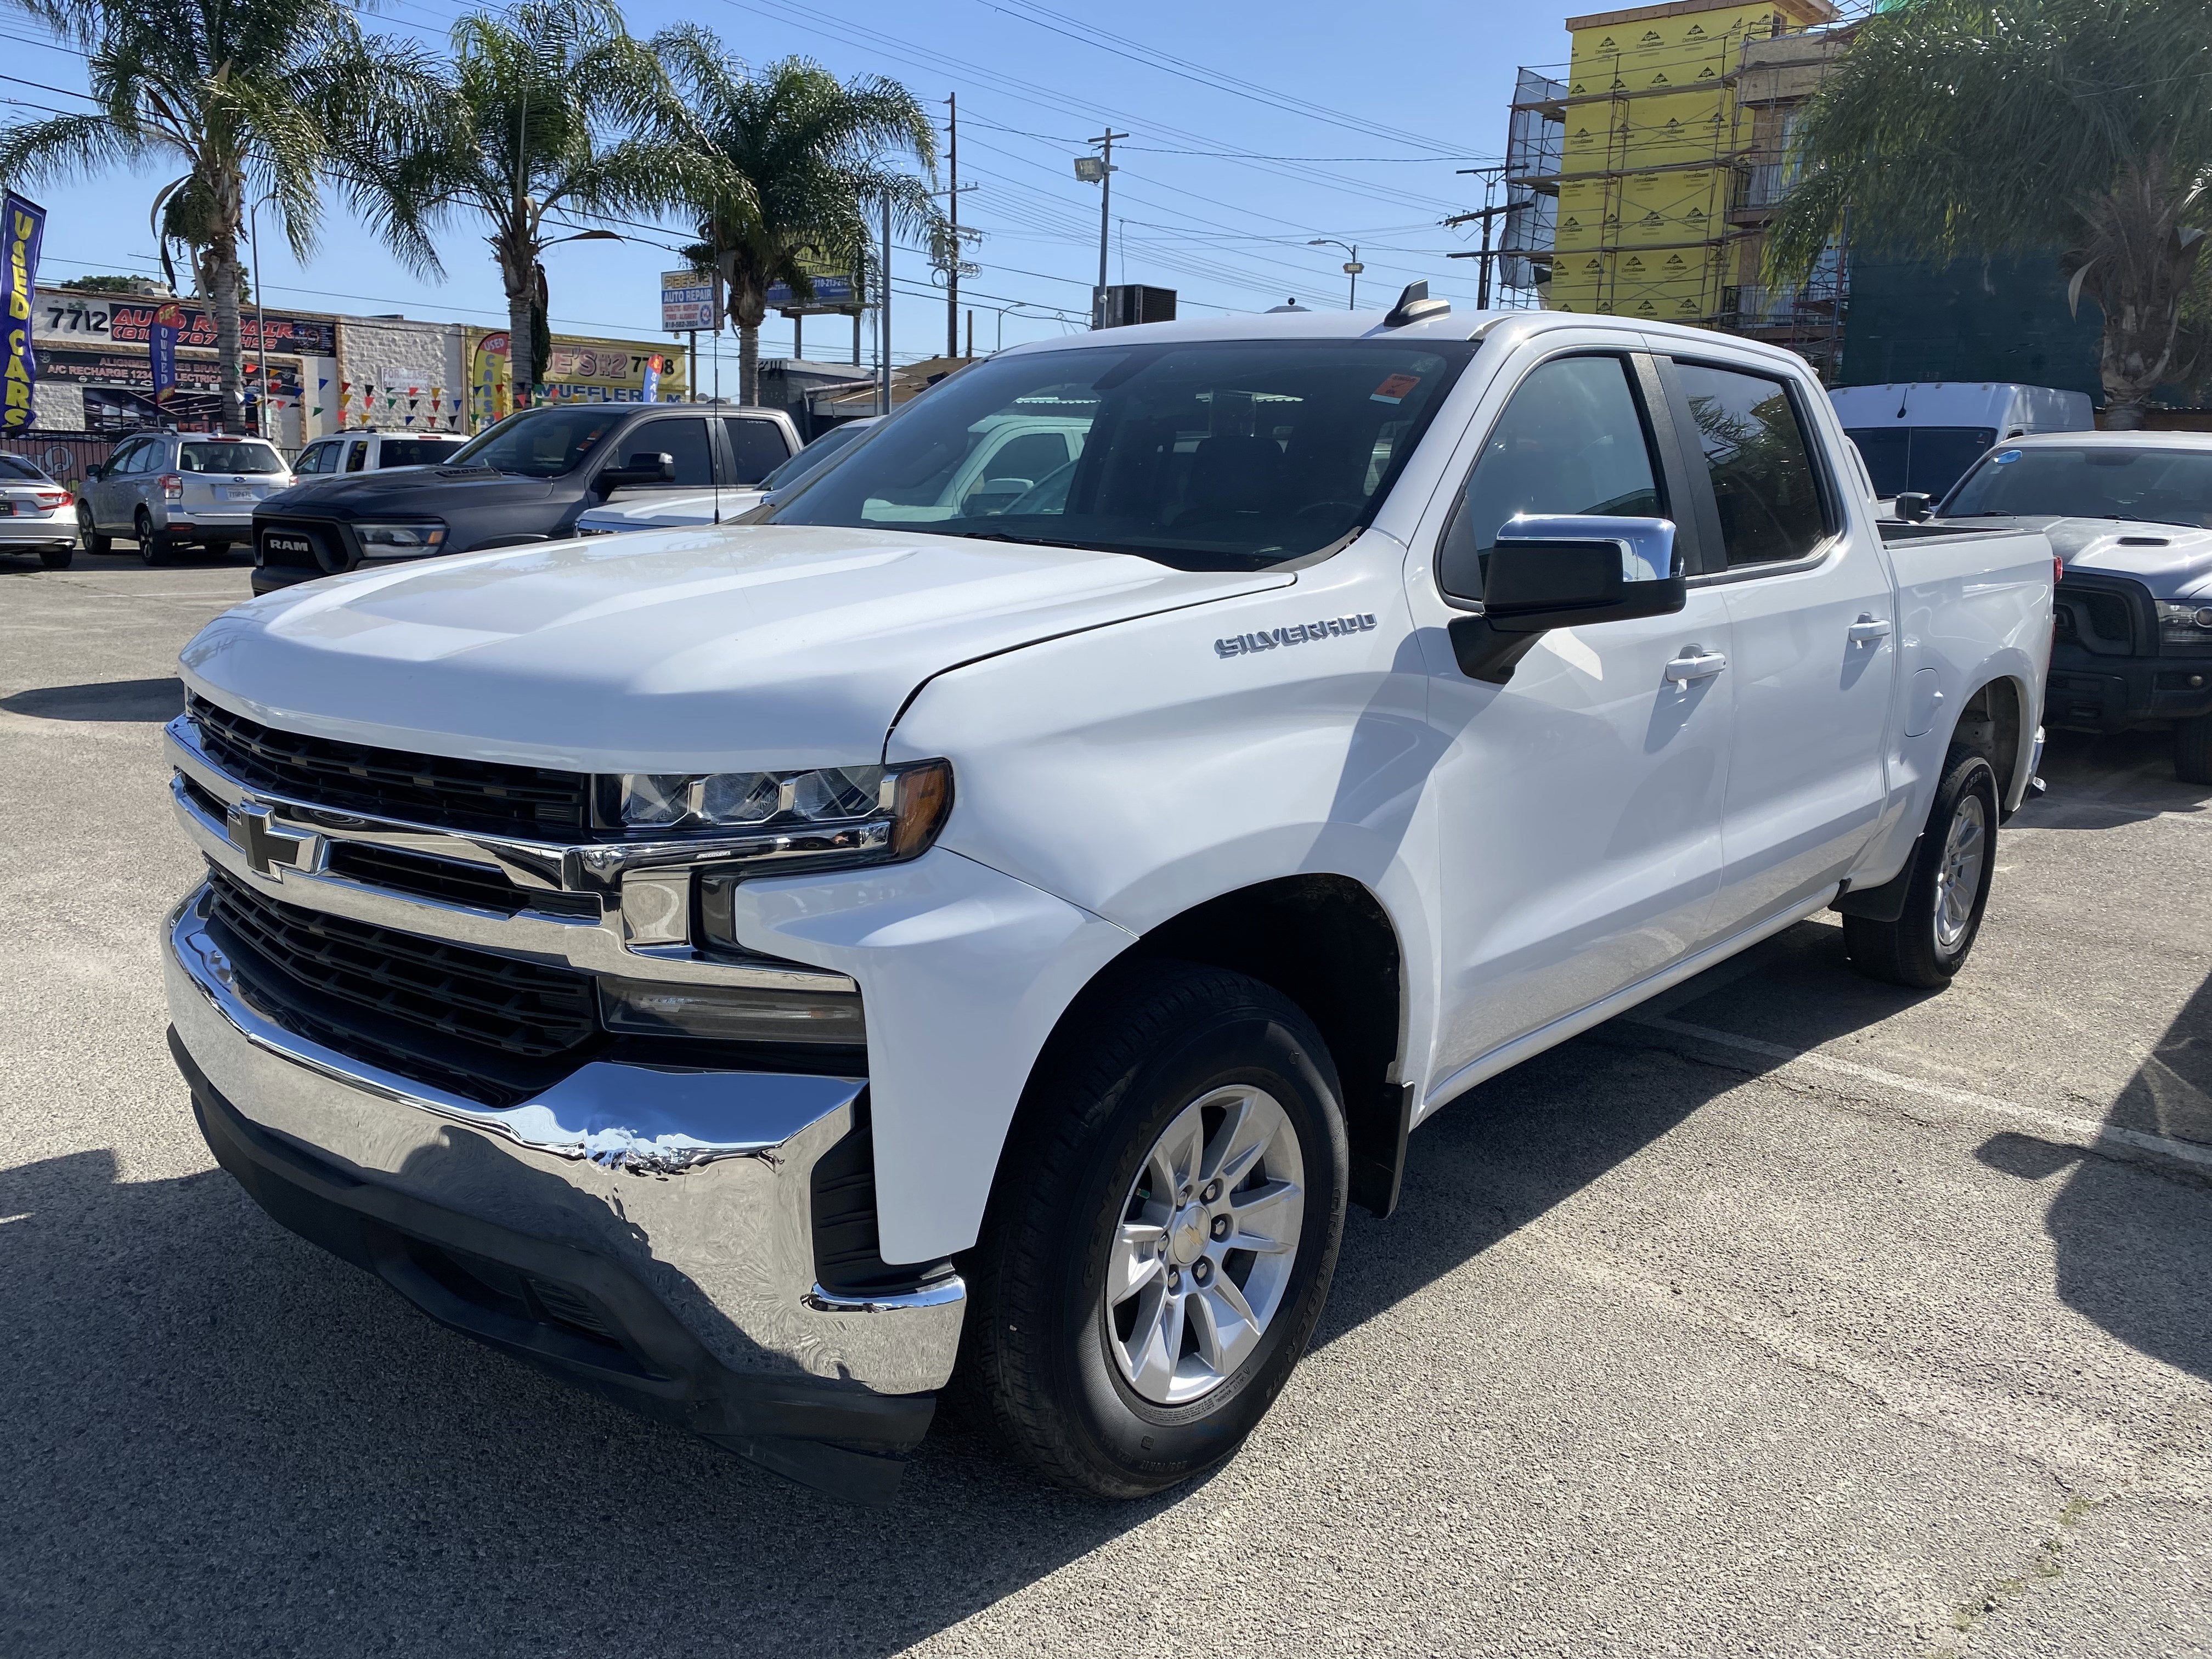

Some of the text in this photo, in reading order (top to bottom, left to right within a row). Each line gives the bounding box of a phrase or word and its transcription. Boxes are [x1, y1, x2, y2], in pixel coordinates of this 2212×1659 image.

[664, 289, 712, 302] AUTO REPAIR
[1, 210, 34, 428] USED CARS
[47, 307, 109, 332] 7712
[159, 306, 176, 323] PRE
[483, 337, 505, 351] USED
[160, 328, 168, 384] OWNED
[47, 364, 66, 374] A/C
[69, 366, 129, 378] RECHARGE
[383, 368, 399, 379] FOR
[270, 539, 308, 551] RAM
[1214, 612, 1377, 659] SILVERADO
[1285, 1188, 1341, 1363] GRABBER
